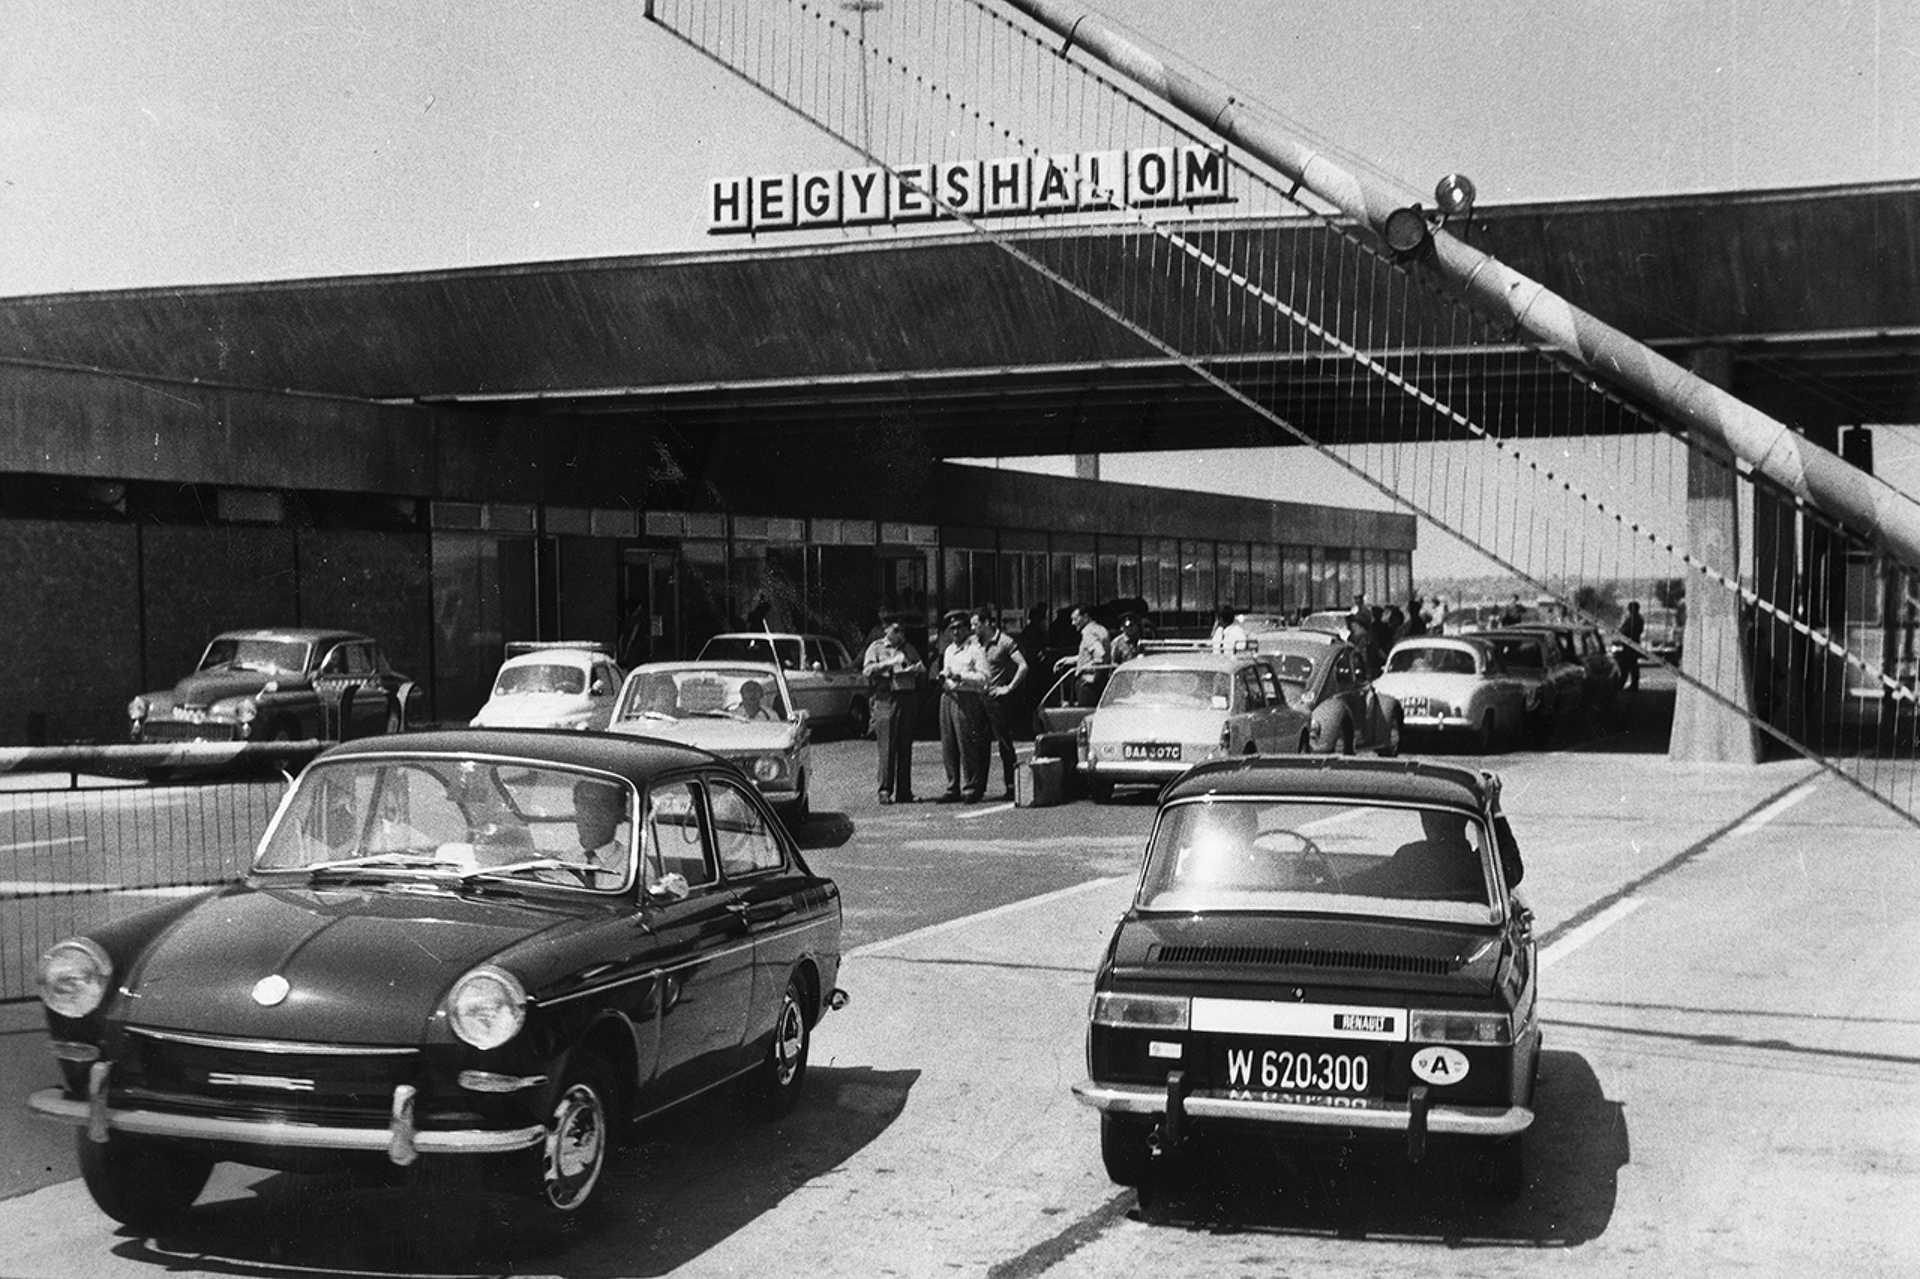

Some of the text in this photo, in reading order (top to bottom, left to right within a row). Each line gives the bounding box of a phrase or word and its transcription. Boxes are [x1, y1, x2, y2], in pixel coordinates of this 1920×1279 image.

[714, 150, 1219, 222] HEGYESHALOM
[1342, 1013, 1387, 1033] RENAULT
[1227, 1048, 1254, 1085] W
[1430, 1055, 1449, 1075] A
